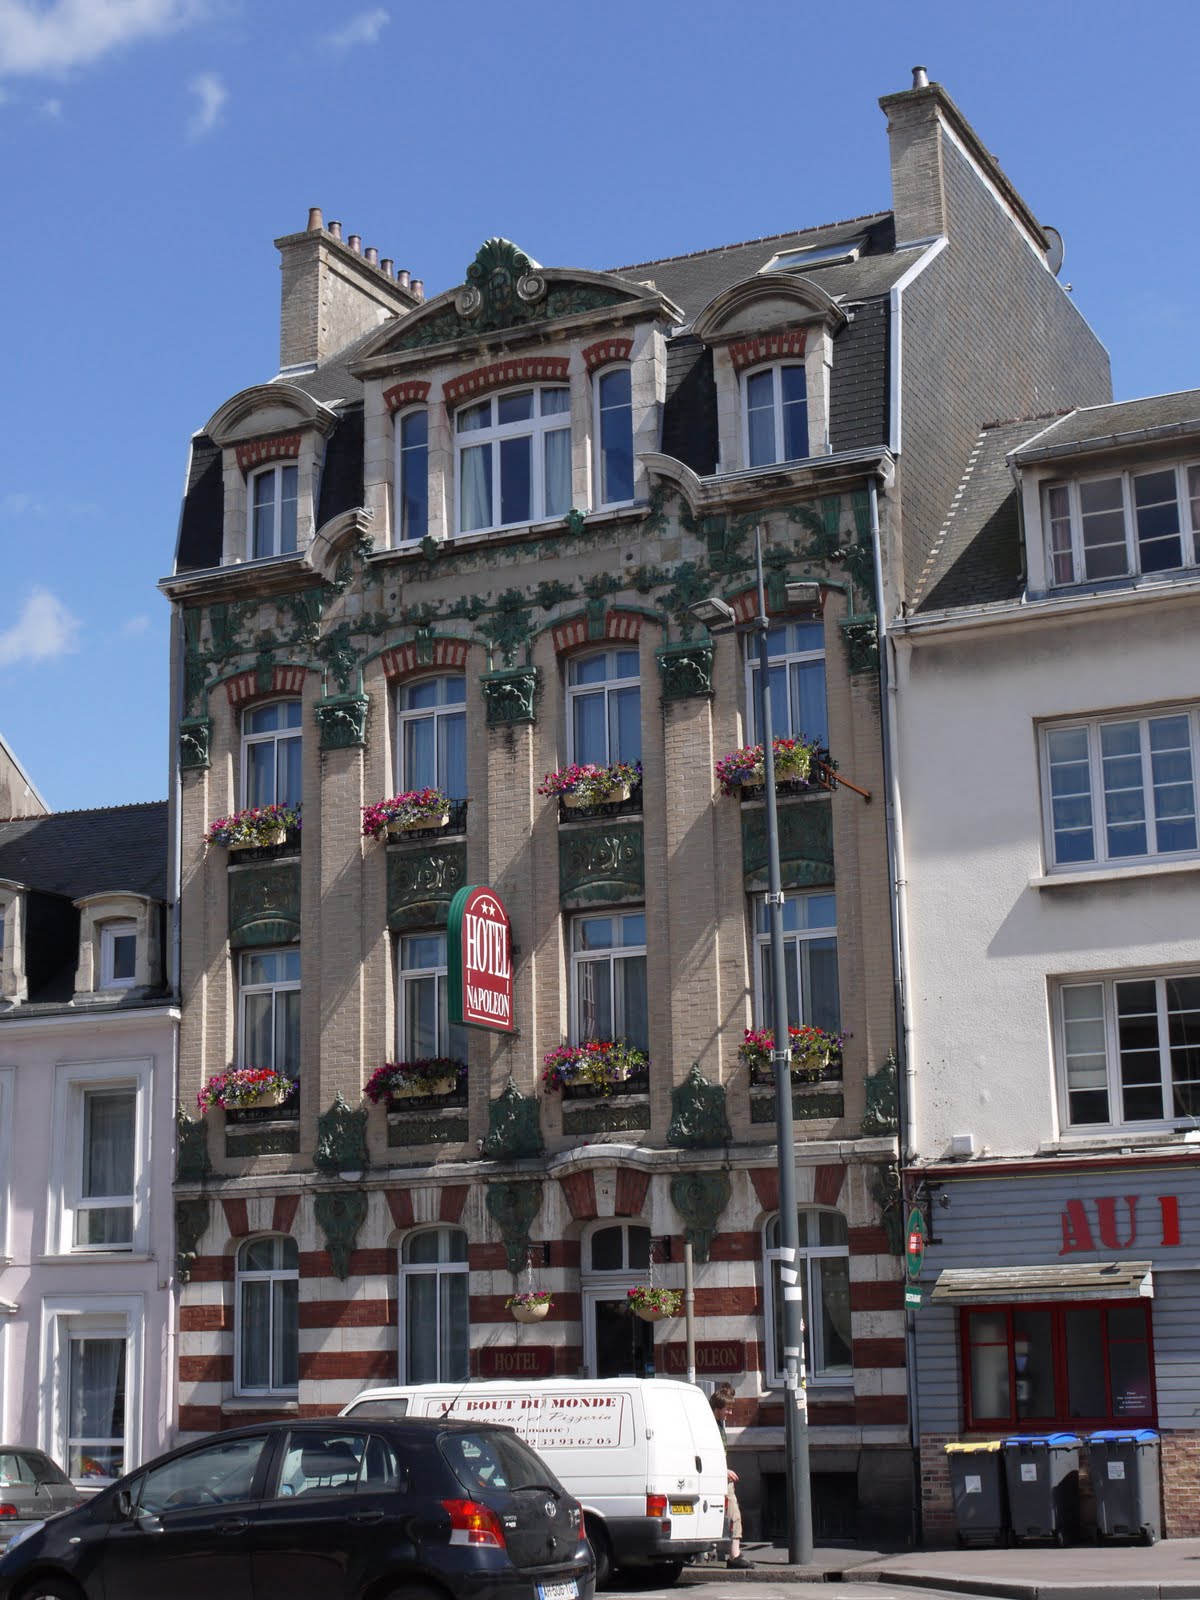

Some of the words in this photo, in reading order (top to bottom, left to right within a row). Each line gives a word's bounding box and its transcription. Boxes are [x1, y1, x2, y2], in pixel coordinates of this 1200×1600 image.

[466, 913, 511, 979] HOTEL
[466, 985, 510, 1018] NAPOLEON
[1058, 1195, 1139, 1256] AU
[493, 1352, 540, 1371] HOTEL
[670, 1347, 738, 1368] NAOLEON
[437, 1401, 461, 1412] AU
[466, 1400, 516, 1411] BOUT
[520, 1399, 547, 1409] DU
[551, 1397, 617, 1409] MONDE
[549, 1411, 612, 1424] Pizzeria
[528, 1426, 564, 1434] mairie
[540, 1438, 555, 1446] 33
[559, 1438, 574, 1446] 93
[577, 1438, 593, 1446] 67
[596, 1437, 612, 1446] 05
